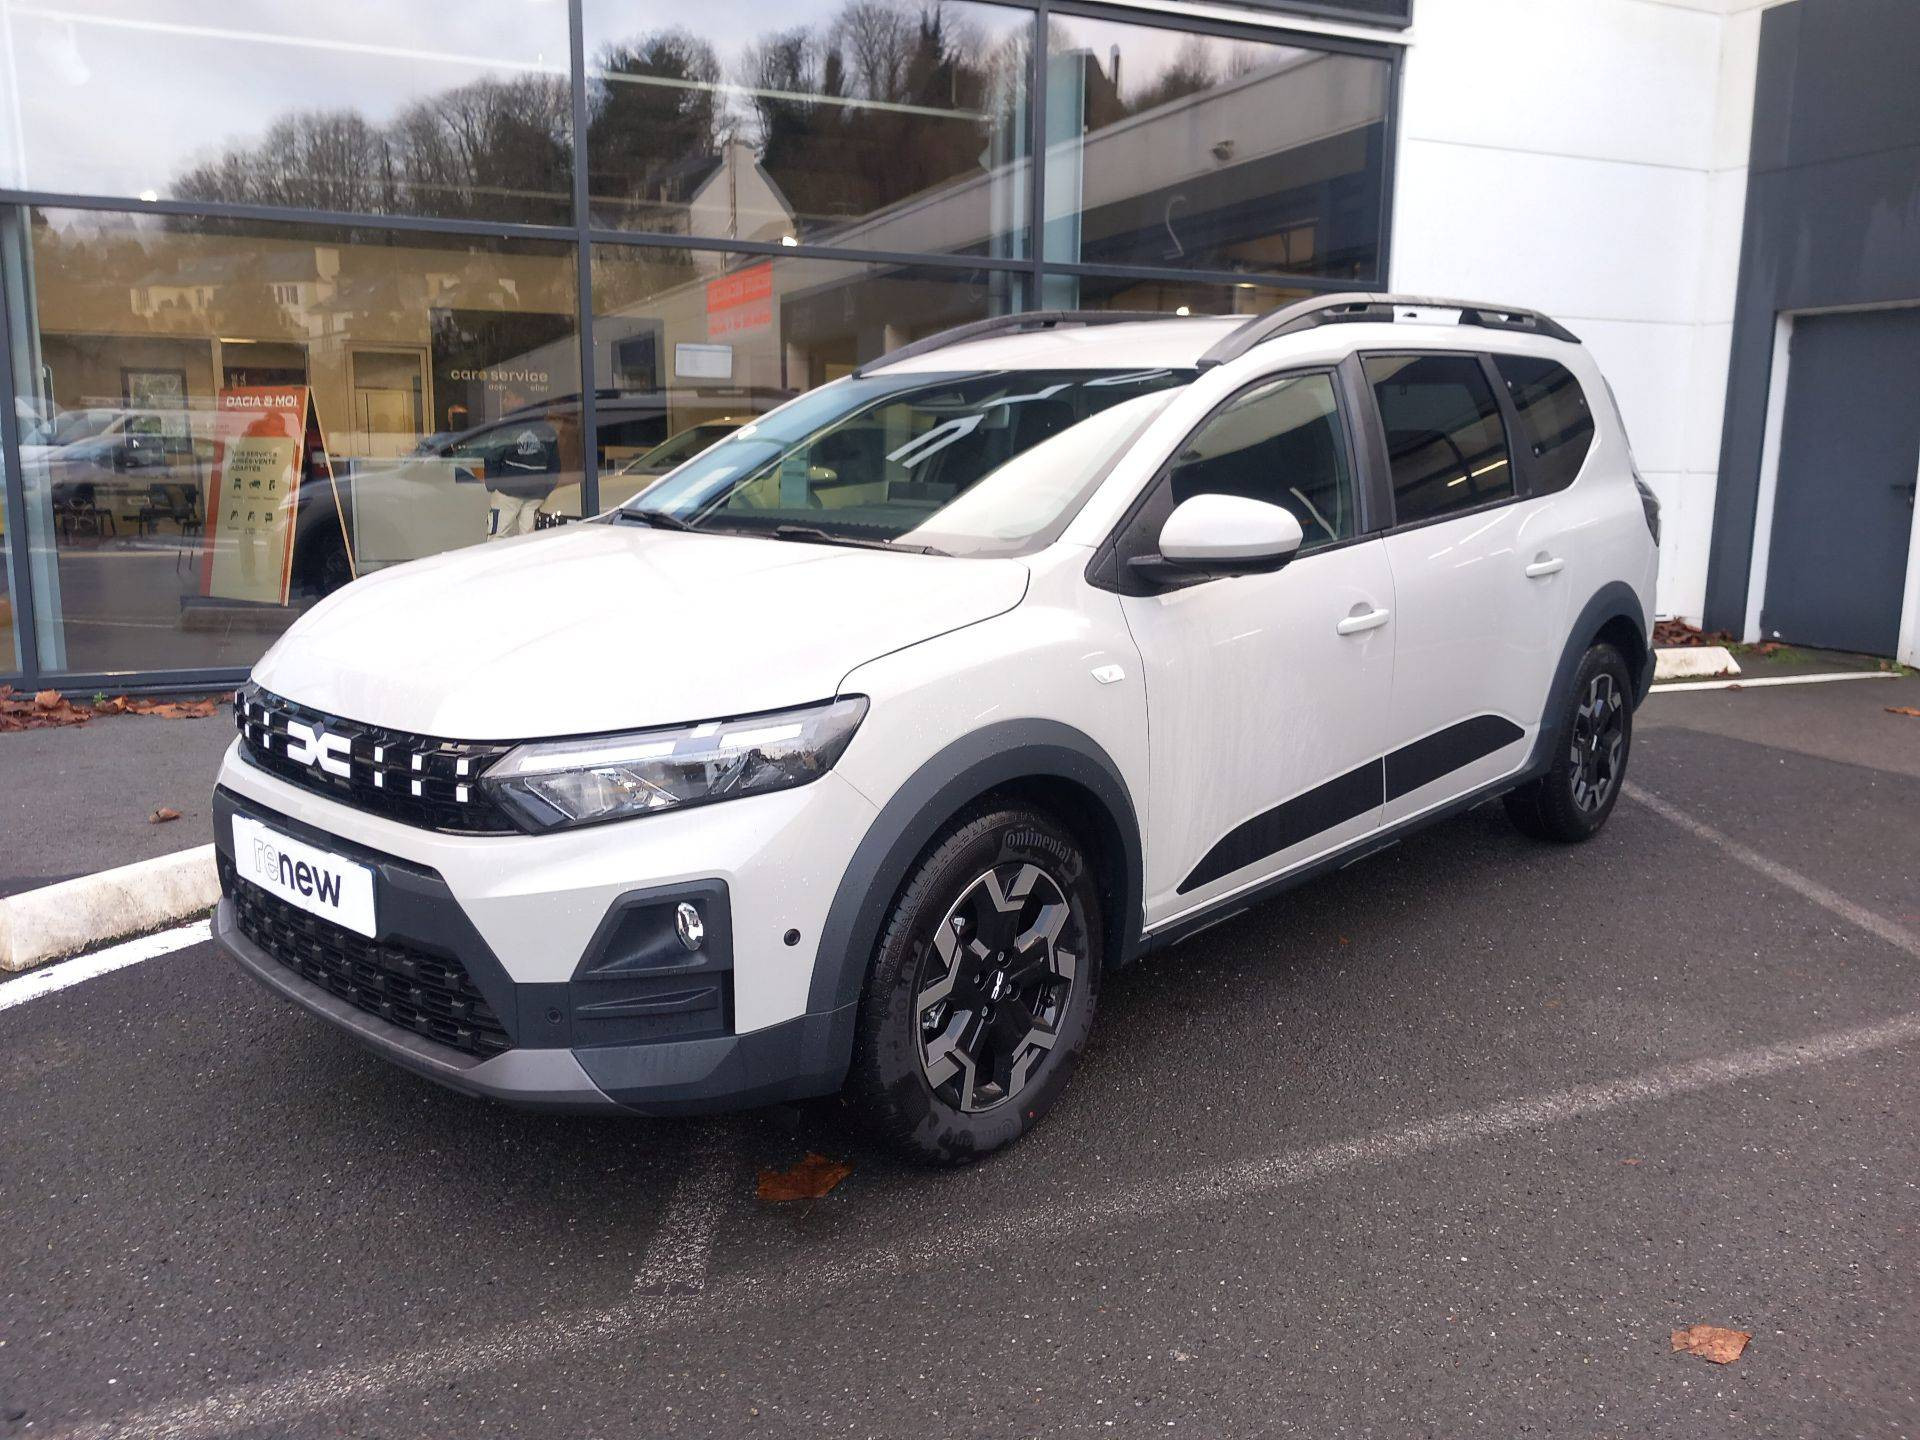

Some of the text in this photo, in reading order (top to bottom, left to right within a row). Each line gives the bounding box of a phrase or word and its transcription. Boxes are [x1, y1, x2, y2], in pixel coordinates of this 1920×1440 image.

[451, 369, 548, 382] care service
[226, 395, 261, 407] DACIA
[275, 394, 297, 407] MOI
[254, 838, 341, 908] renew
